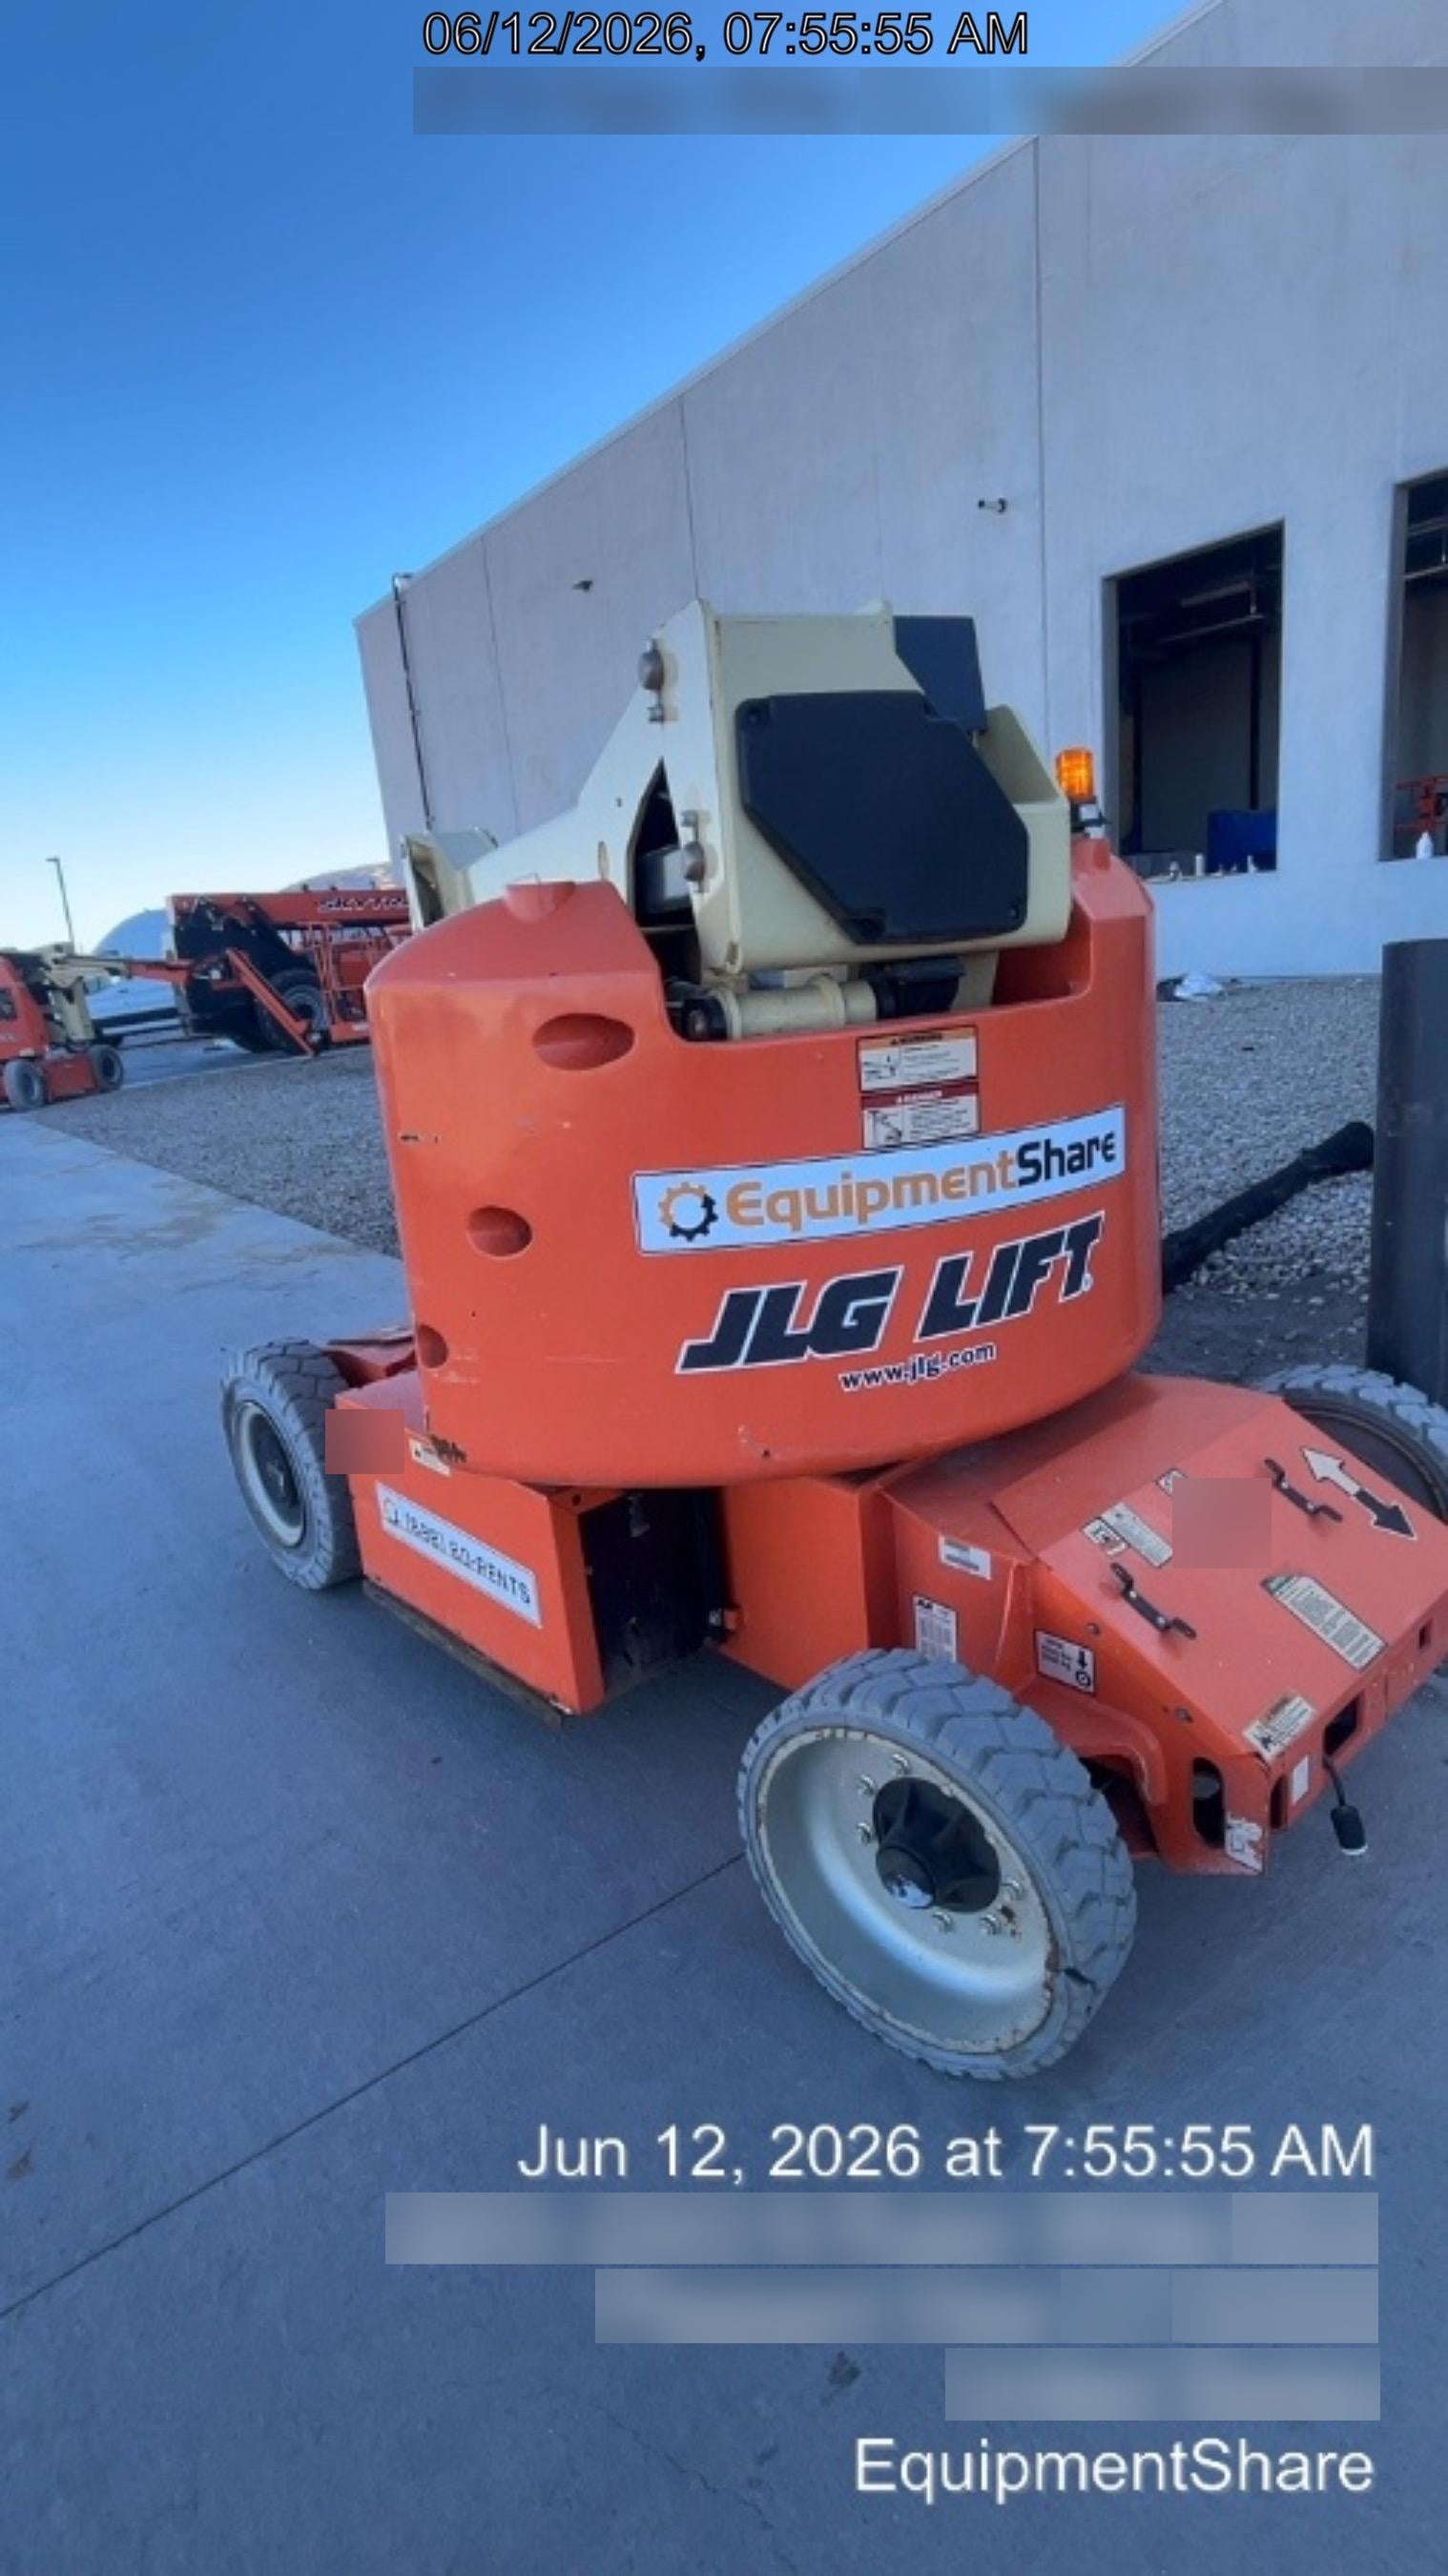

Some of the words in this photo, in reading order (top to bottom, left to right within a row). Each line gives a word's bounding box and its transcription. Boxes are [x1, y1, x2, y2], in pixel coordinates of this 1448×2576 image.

[727, 1131, 1117, 1232] EquipmentShare
[675, 1266, 904, 1374] JLG
[838, 1341, 997, 1392] www.jlg.com
